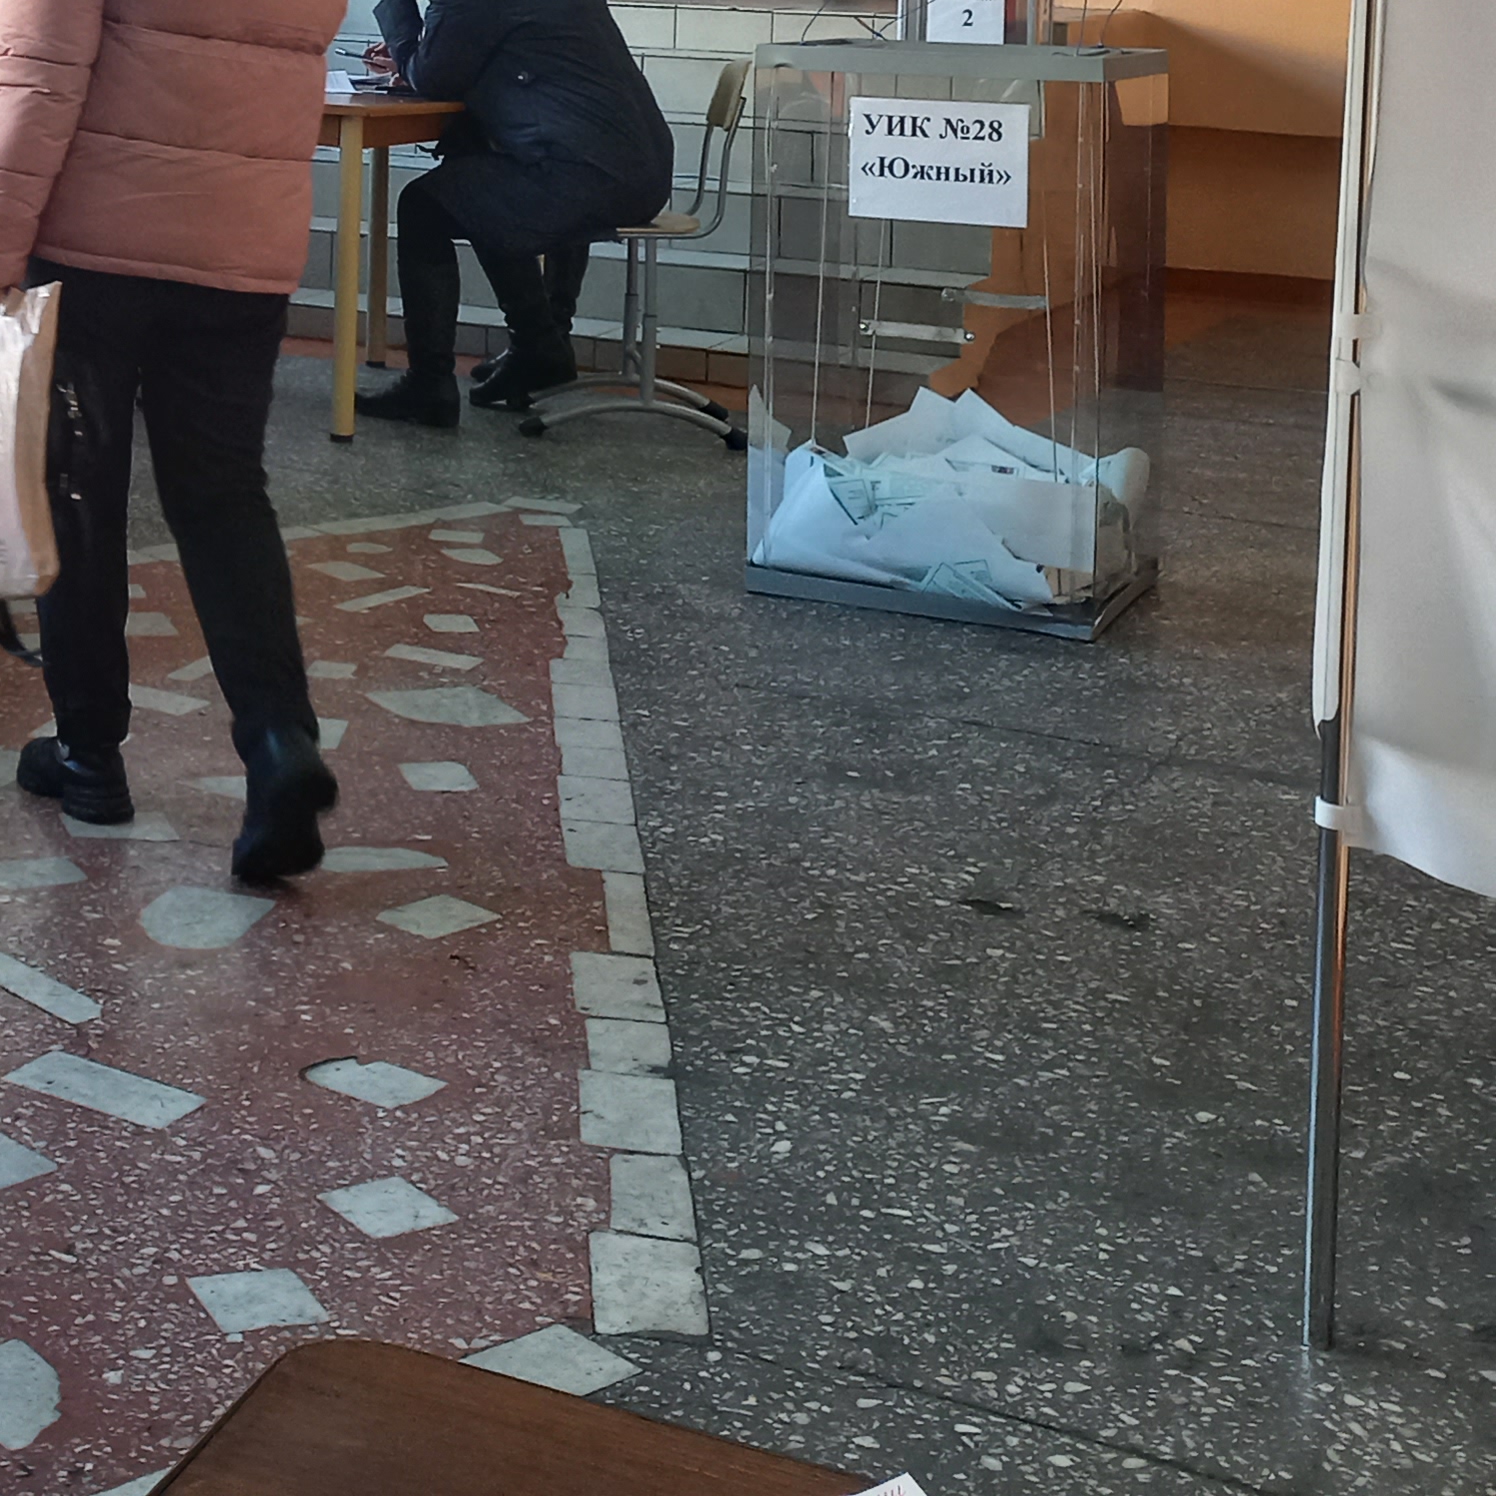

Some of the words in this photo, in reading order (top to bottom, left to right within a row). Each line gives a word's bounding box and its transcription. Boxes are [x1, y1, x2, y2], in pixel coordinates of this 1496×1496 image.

[961, 8, 974, 27] 2
[862, 112, 932, 139] УИК
[938, 116, 1004, 143] №28
[860, 155, 1013, 186] «Южный»
